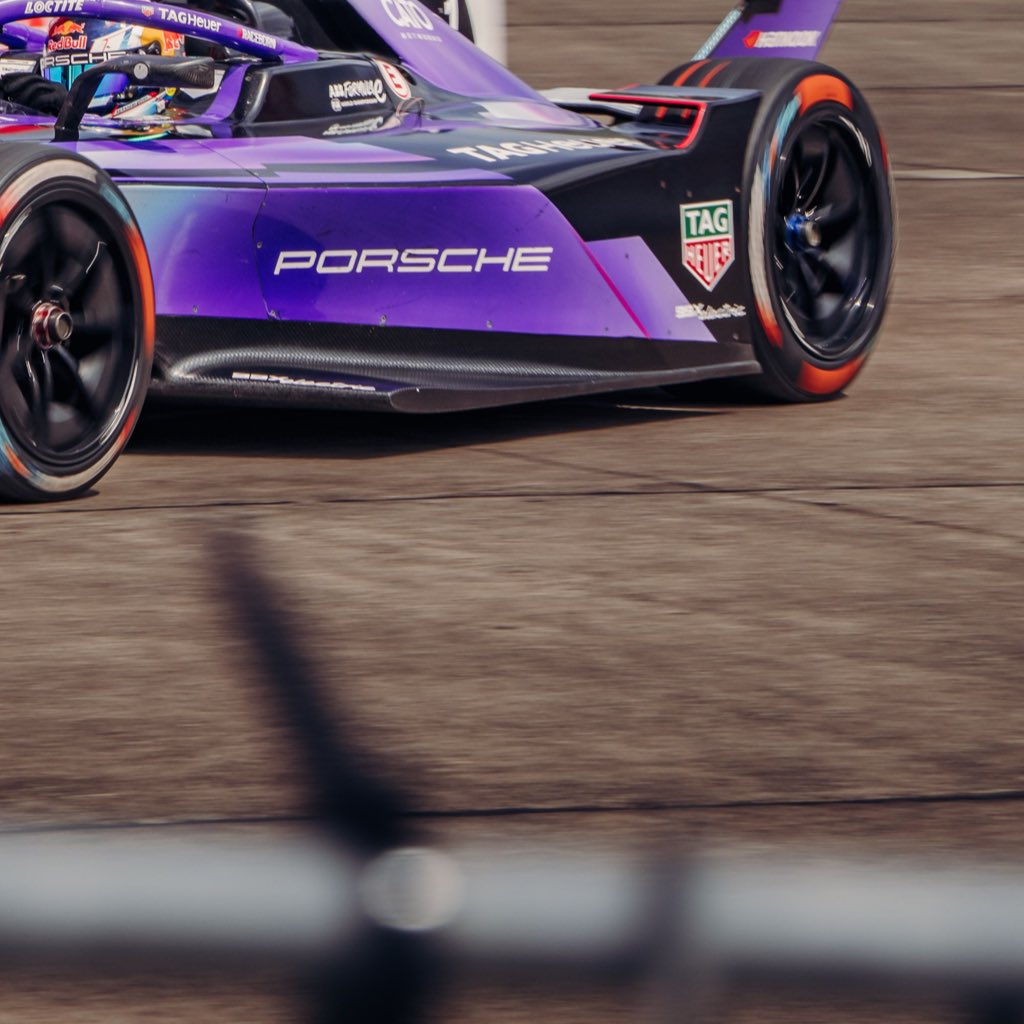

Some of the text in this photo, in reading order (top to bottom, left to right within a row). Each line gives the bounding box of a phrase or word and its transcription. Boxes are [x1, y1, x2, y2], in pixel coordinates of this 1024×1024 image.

[685, 206, 729, 236] TAG
[273, 246, 555, 276] PORSCHE
[686, 239, 732, 285] HEUER
